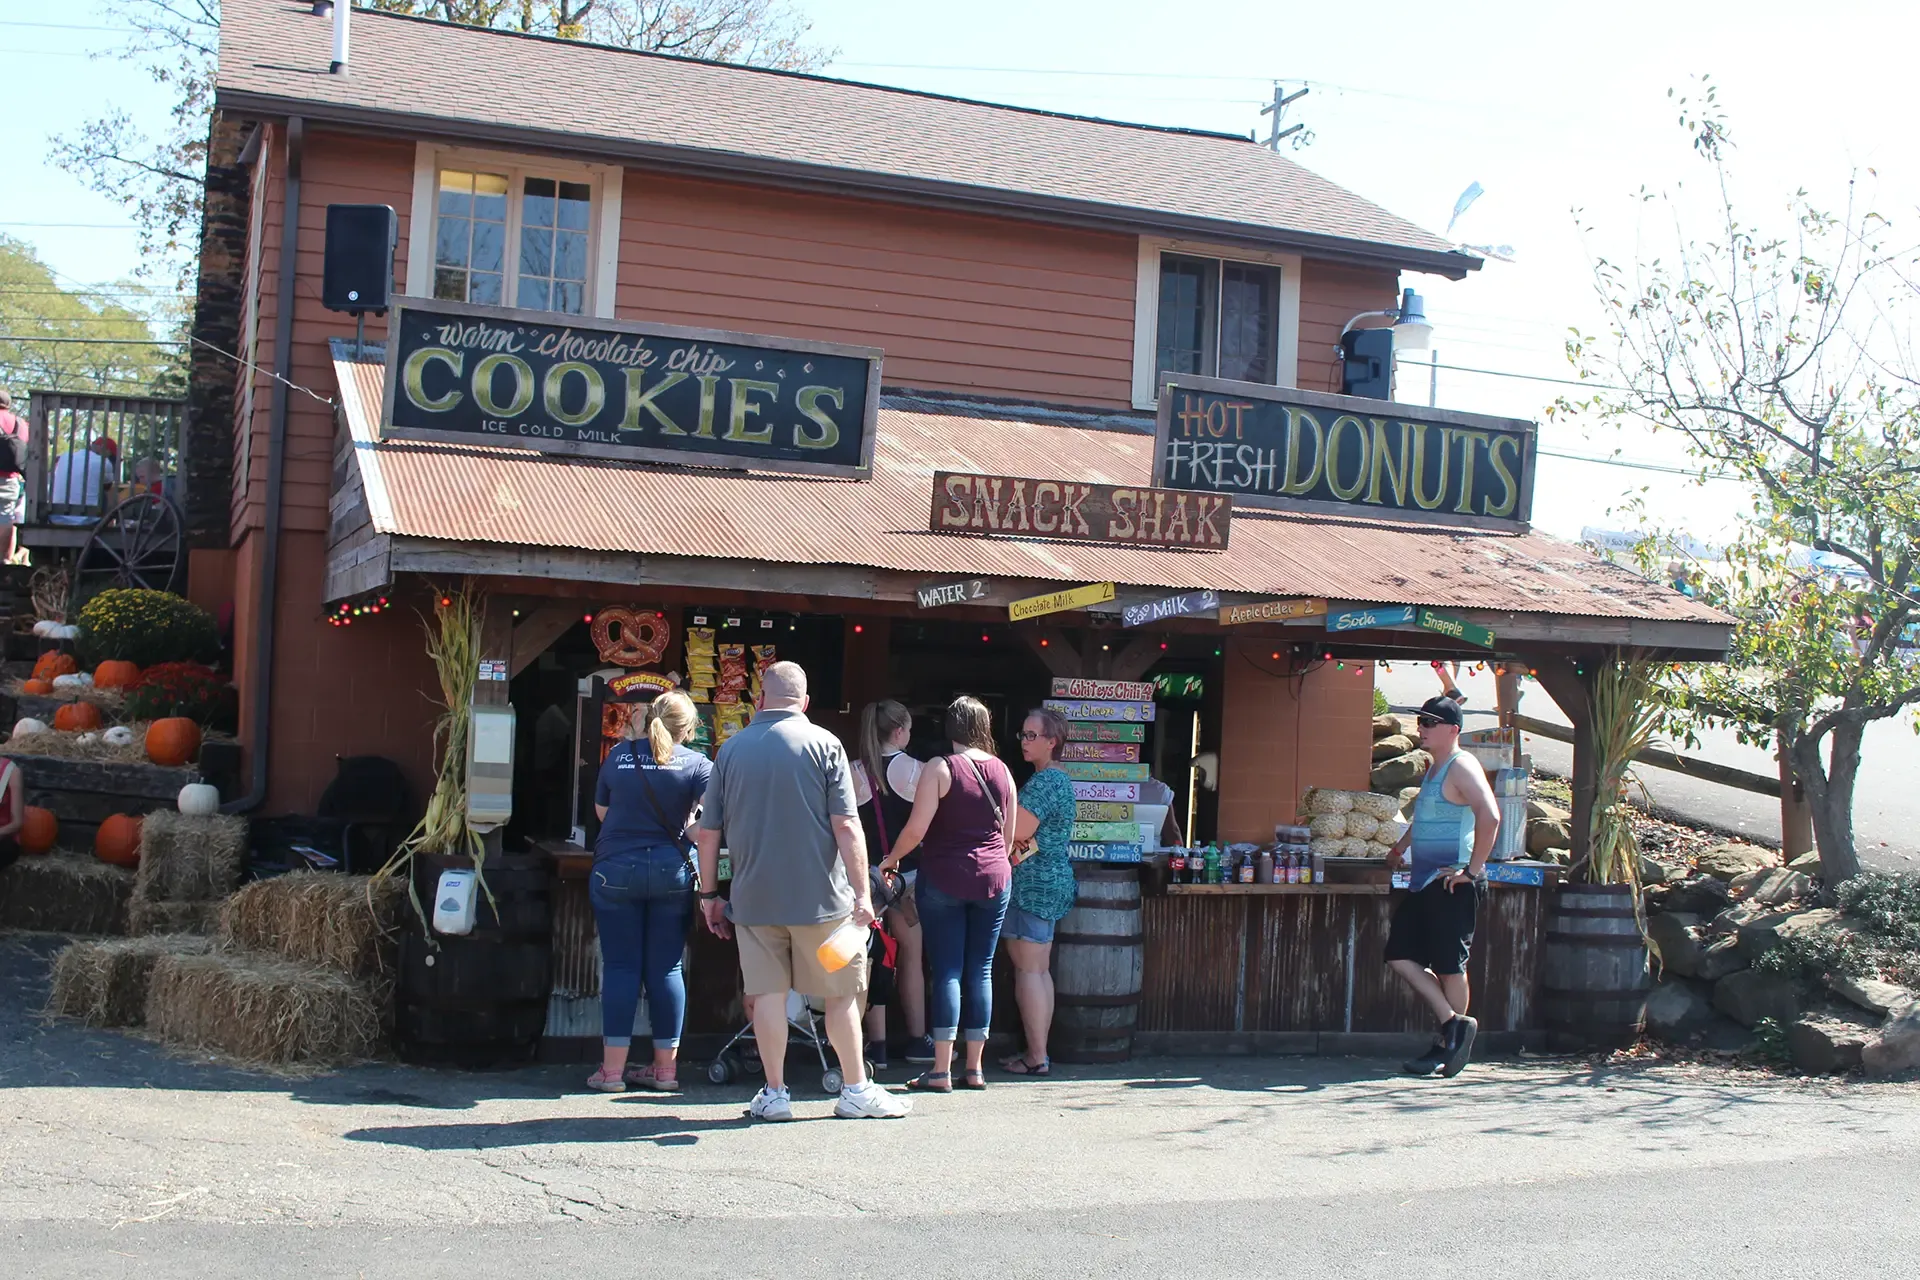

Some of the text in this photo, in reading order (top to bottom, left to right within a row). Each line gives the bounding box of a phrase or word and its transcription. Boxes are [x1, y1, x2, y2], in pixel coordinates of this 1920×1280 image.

[530, 328, 659, 366] chocolate
[660, 345, 735, 374] chip
[402, 347, 844, 449] COOKIES
[1178, 396, 1254, 440] HOT
[482, 420, 621, 443] ICE COLD MILK
[1166, 438, 1277, 490] FRESH
[1278, 405, 1520, 517] DONUTS
[942, 476, 1223, 545] SNACK SHAK
[918, 581, 985, 607] WATER 2
[1013, 583, 1112, 617] Chocolate Milk 2
[1153, 590, 1216, 618] Milk 2
[1125, 605, 1139, 622] ICE
[1132, 604, 1150, 625] COLD
[1230, 600, 1314, 623] Apple Cider 2
[1336, 606, 1413, 630] Soda 2
[1423, 611, 1495, 645] Snapple 3
[1069, 679, 1152, 701] Whiteys Chili 4
[1141, 704, 1151, 720] 5
[1131, 724, 1144, 742] 4
[1125, 746, 1136, 761] 5
[1127, 785, 1136, 799] 3
[1120, 804, 1129, 820] 3
[1068, 845, 1105, 859] NUTS
[1131, 853, 1141, 862] 10
[1531, 870, 1540, 884] 3
